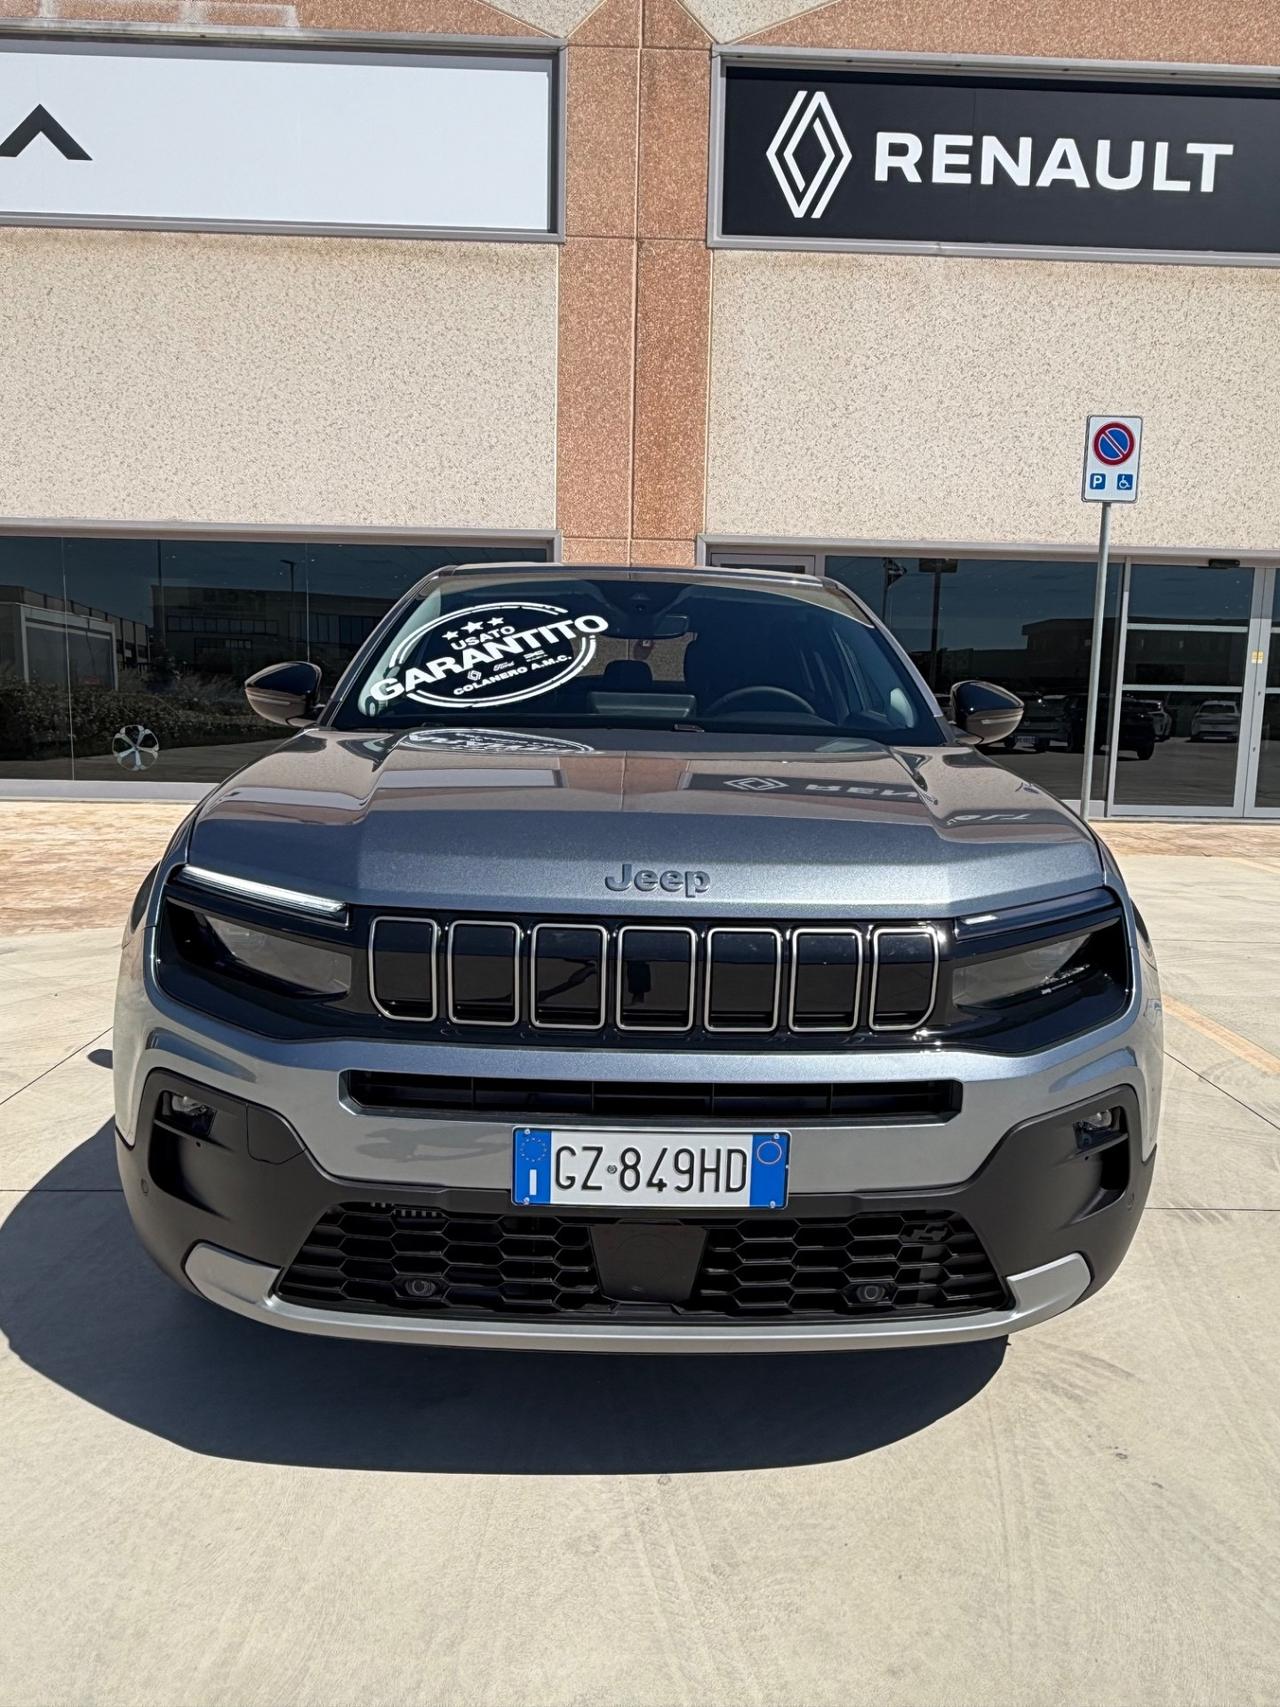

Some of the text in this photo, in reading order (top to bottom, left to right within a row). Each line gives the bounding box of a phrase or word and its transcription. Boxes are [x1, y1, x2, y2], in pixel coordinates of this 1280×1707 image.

[874, 131, 1235, 193] RENAULT
[1093, 475, 1103, 488] P
[450, 625, 516, 650] USATO
[369, 615, 608, 701] GARANTITO
[453, 666, 528, 695] COLANERO
[604, 863, 711, 898] Jeep
